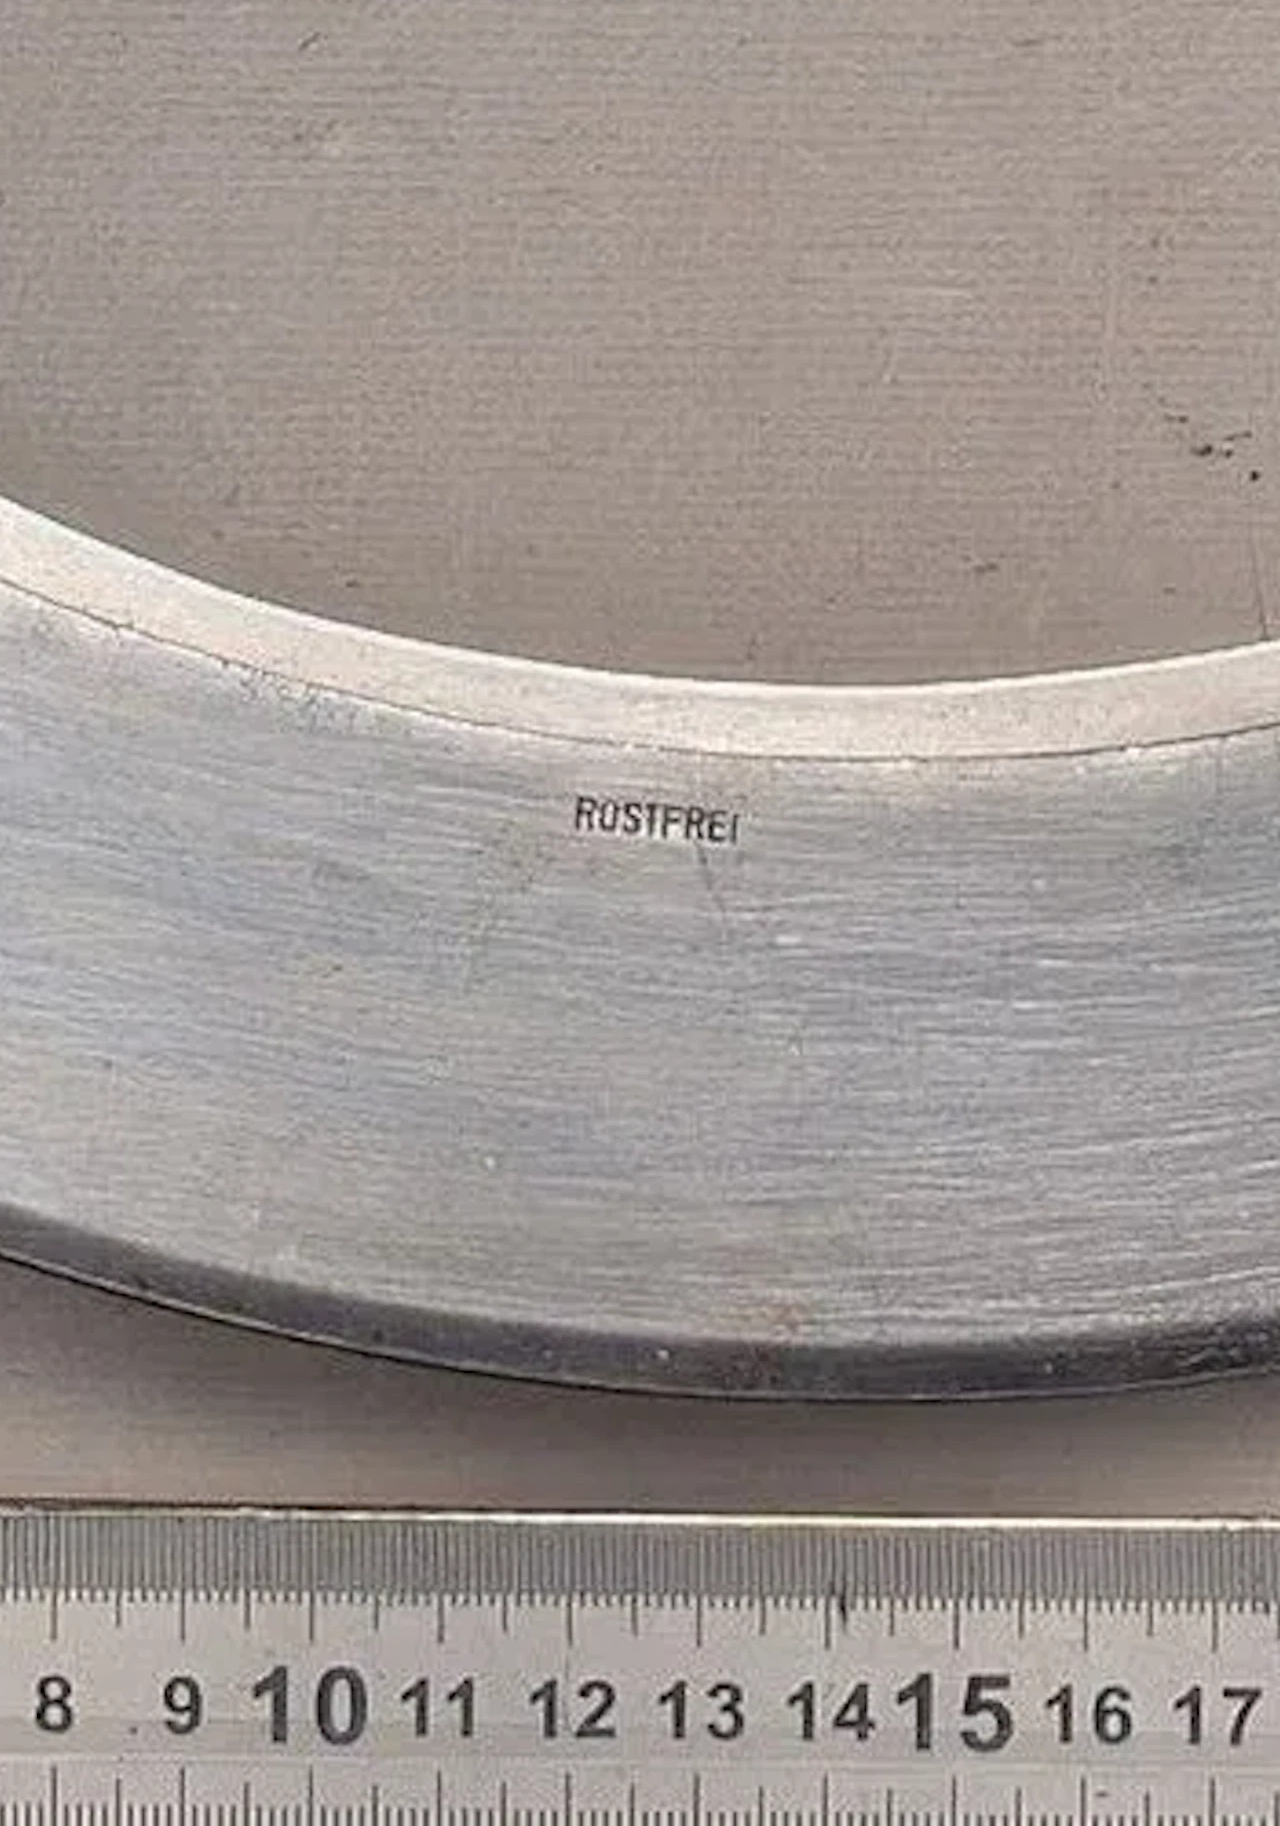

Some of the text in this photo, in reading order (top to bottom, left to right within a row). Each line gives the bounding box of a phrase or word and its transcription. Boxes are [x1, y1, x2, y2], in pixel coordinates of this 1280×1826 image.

[575, 797, 741, 843] ROSTFREI
[35, 1675, 73, 1734] 8
[163, 1676, 202, 1735] 9
[252, 1665, 368, 1746] 10
[400, 1677, 474, 1738] 11
[529, 1679, 616, 1739] 12
[658, 1680, 745, 1741] 13
[787, 1681, 876, 1742] 14
[896, 1672, 1013, 1753] 15
[1045, 1684, 1132, 1745] 16
[1174, 1685, 1262, 1746] 17
